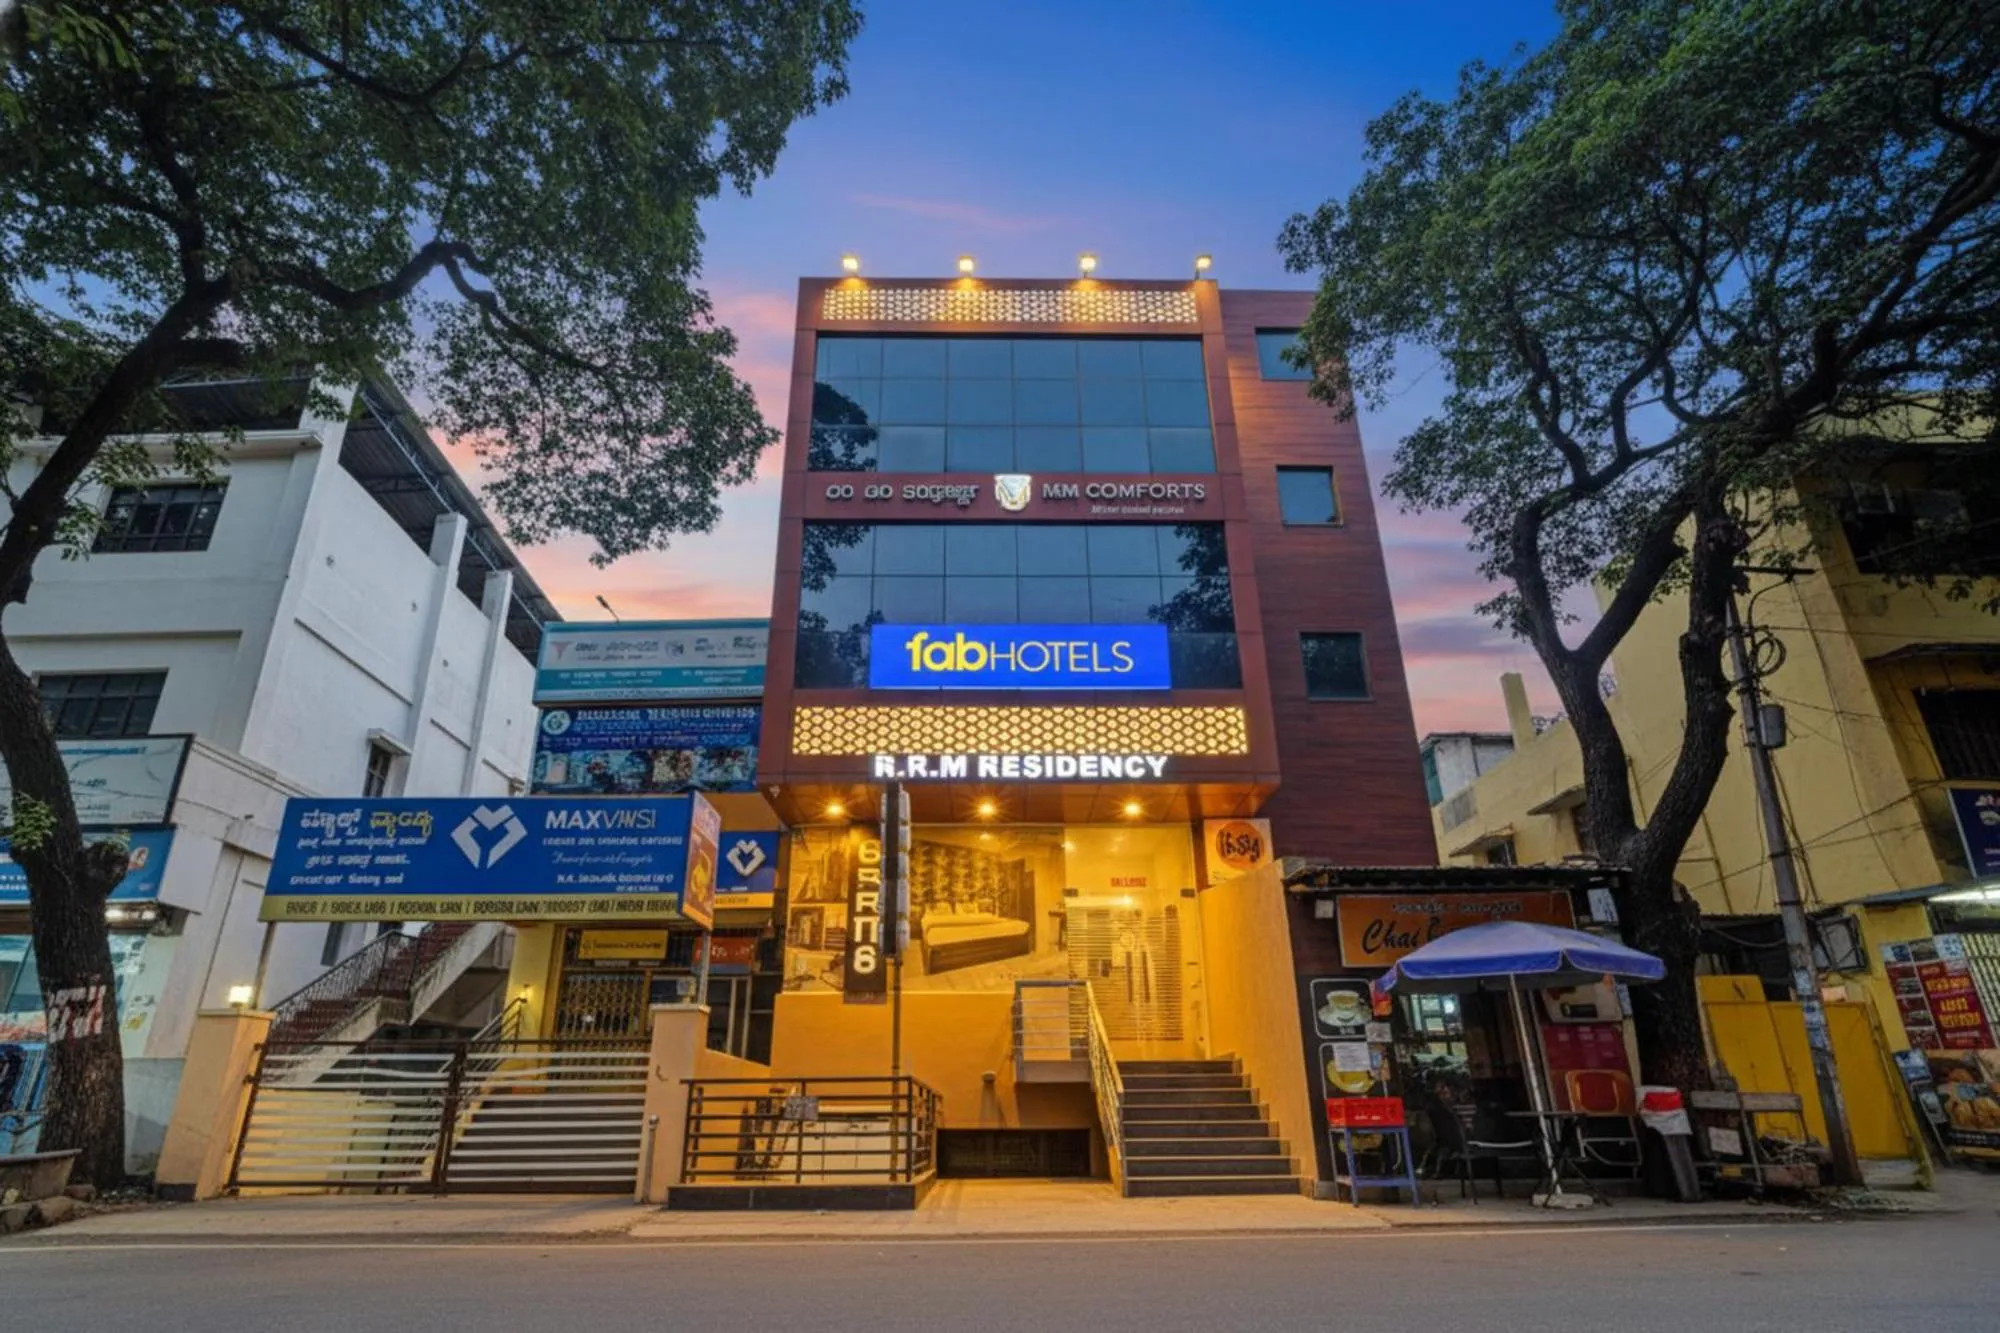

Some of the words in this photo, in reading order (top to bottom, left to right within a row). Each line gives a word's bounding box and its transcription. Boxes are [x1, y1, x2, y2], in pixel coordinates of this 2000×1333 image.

[1042, 482, 1080, 499] MM
[1086, 482, 1206, 499] COMFORTS
[874, 754, 968, 779] R.R.M
[977, 754, 1169, 779] RESIDENCY
[1361, 918, 1422, 955] Chai
